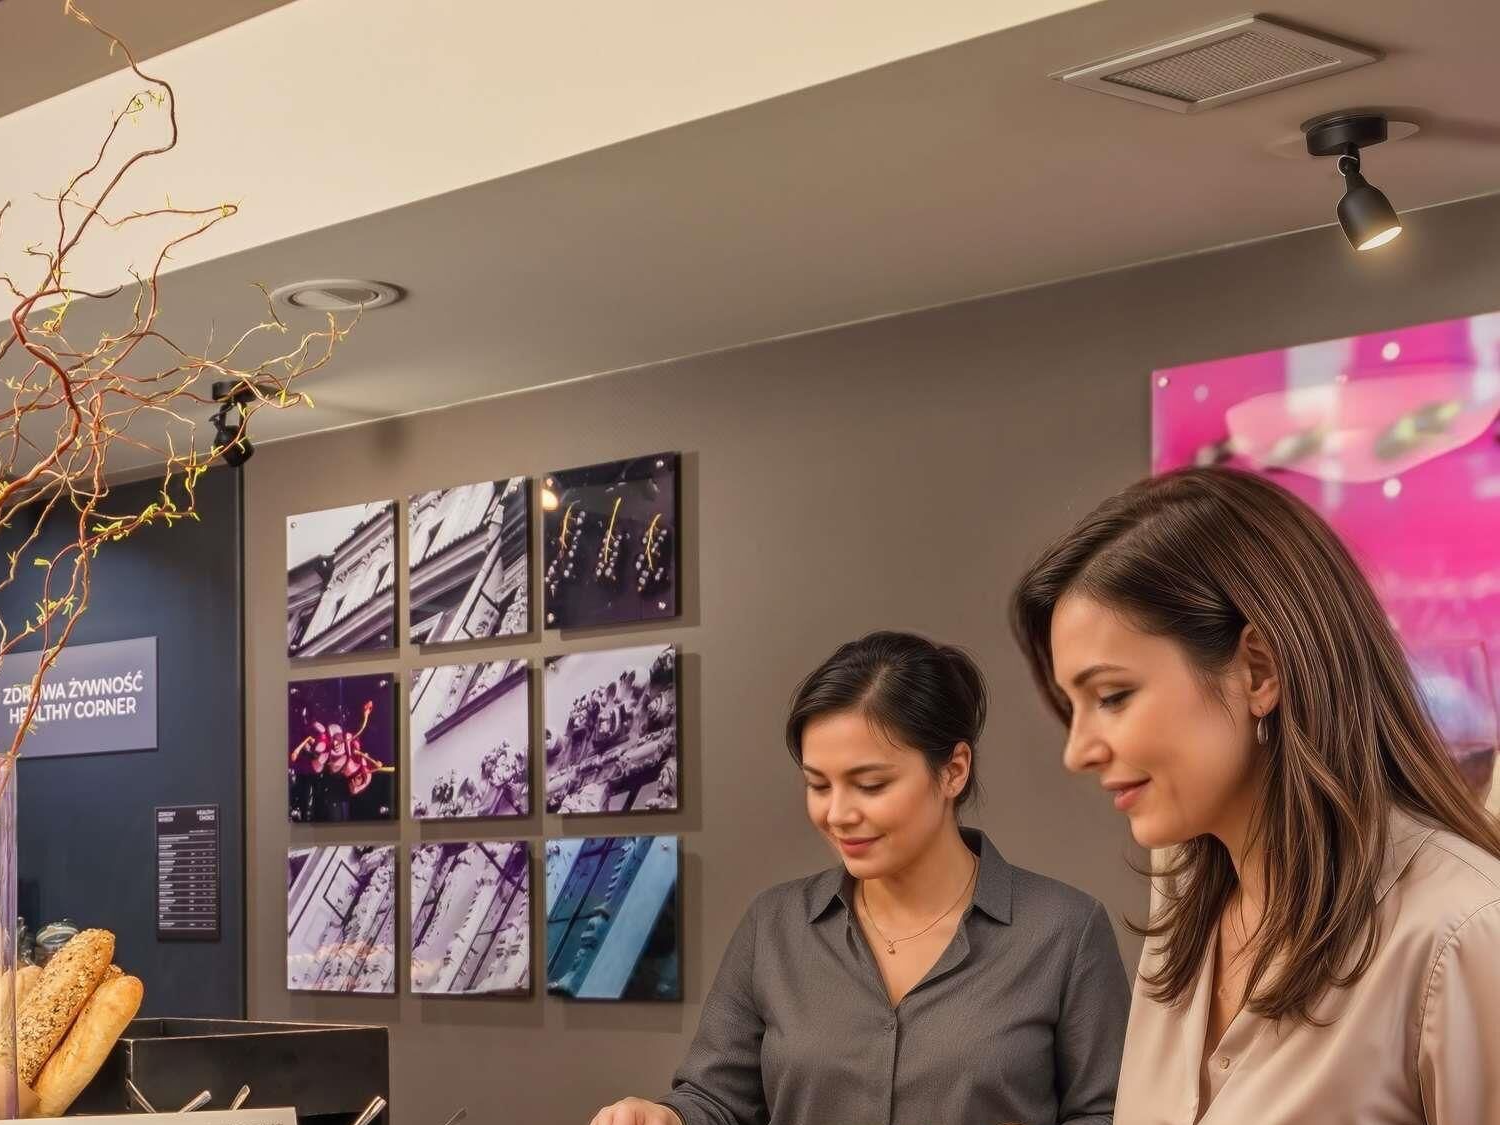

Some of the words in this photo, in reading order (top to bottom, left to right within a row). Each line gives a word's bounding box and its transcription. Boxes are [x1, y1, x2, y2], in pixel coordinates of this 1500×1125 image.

[2, 683, 66, 705] ZDRWA
[68, 670, 144, 699] ŻYWNOŚĆ
[74, 697, 137, 718] CORNER
